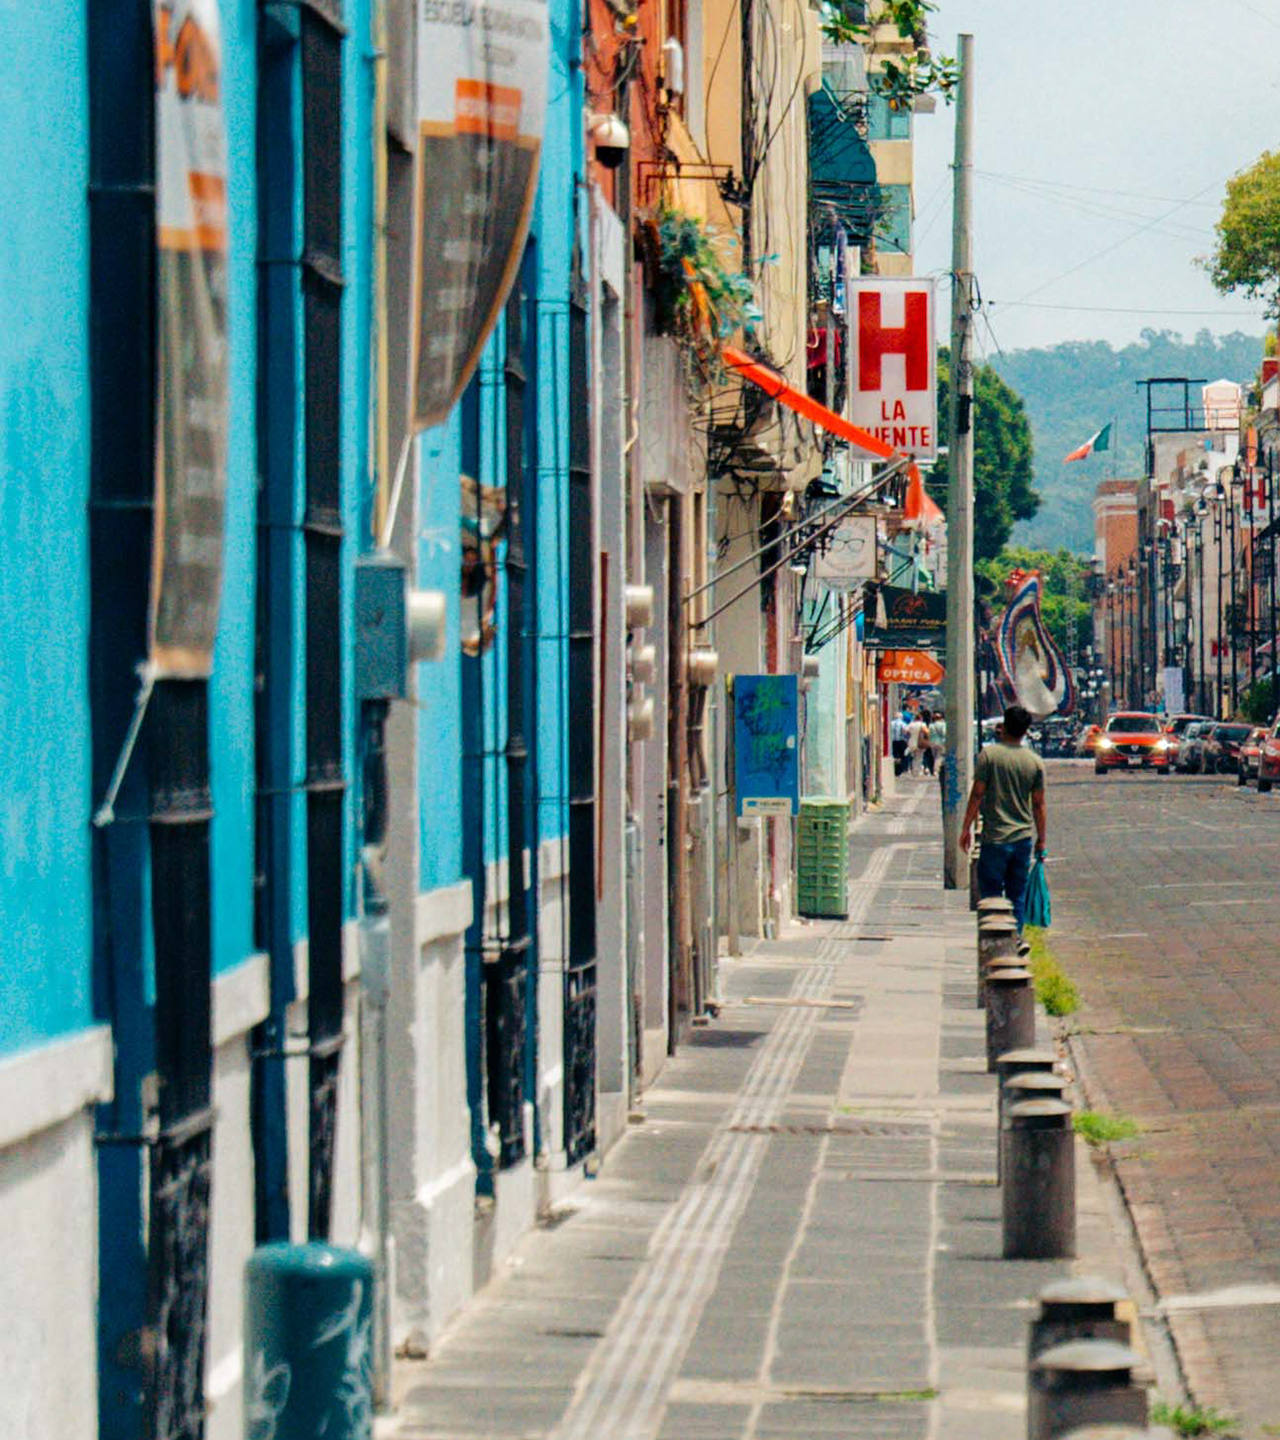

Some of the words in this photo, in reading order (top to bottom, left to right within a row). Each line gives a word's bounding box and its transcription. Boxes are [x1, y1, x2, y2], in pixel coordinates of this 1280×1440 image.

[859, 292, 927, 391] H
[881, 400, 906, 421] LA
[862, 426, 930, 447] UENTE
